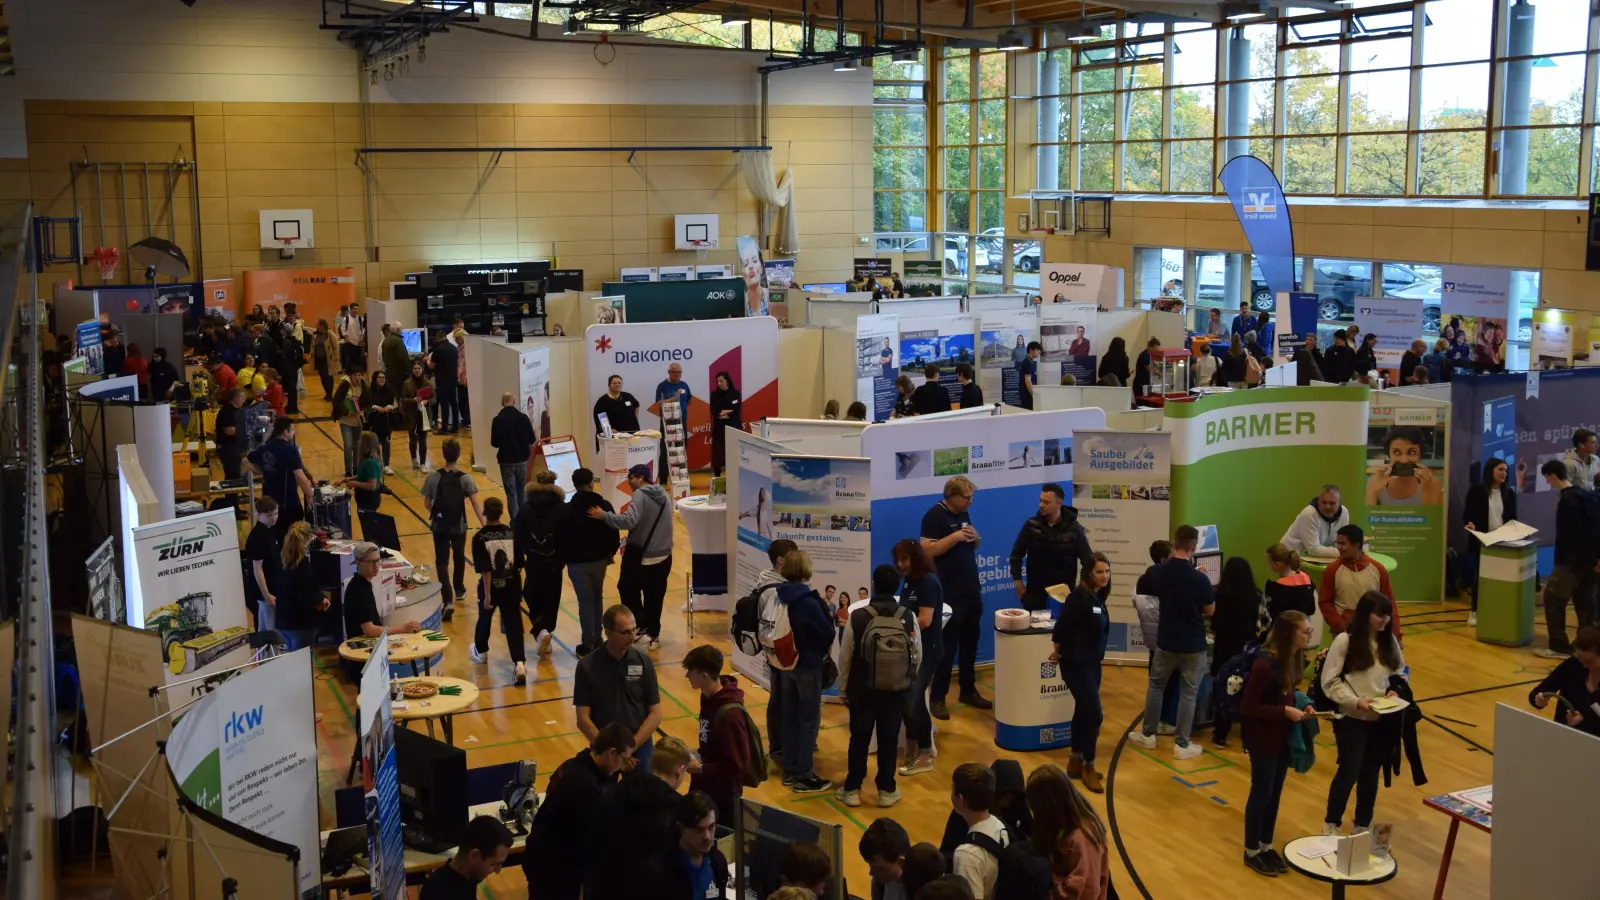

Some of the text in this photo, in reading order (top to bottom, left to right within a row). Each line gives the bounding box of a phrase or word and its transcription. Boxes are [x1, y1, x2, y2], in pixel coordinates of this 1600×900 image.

[1049, 271, 1082, 284] Oppel
[706, 291, 726, 300] AOK
[615, 348, 693, 364] Diakoneo
[1206, 412, 1316, 445] BARMER
[628, 444, 656, 454] Diakoneo
[1090, 450, 1127, 458] Sauber
[1090, 460, 1154, 470] Ausgebildet
[776, 532, 843, 542] Zukunft gestalten.
[977, 554, 1000, 568] ber
[158, 569, 170, 578] WIR
[170, 564, 190, 575] LIEBEN
[978, 564, 1011, 584] gebil
[997, 582, 1014, 590] BRAN
[224, 704, 264, 744] rkw
[244, 770, 258, 782] RKW
[258, 762, 274, 774] reden
[274, 755, 288, 768] nicht
[247, 776, 269, 794] Respekt
[284, 762, 298, 774] leben
[228, 802, 241, 814] Denn
[241, 790, 263, 807] Respekt
